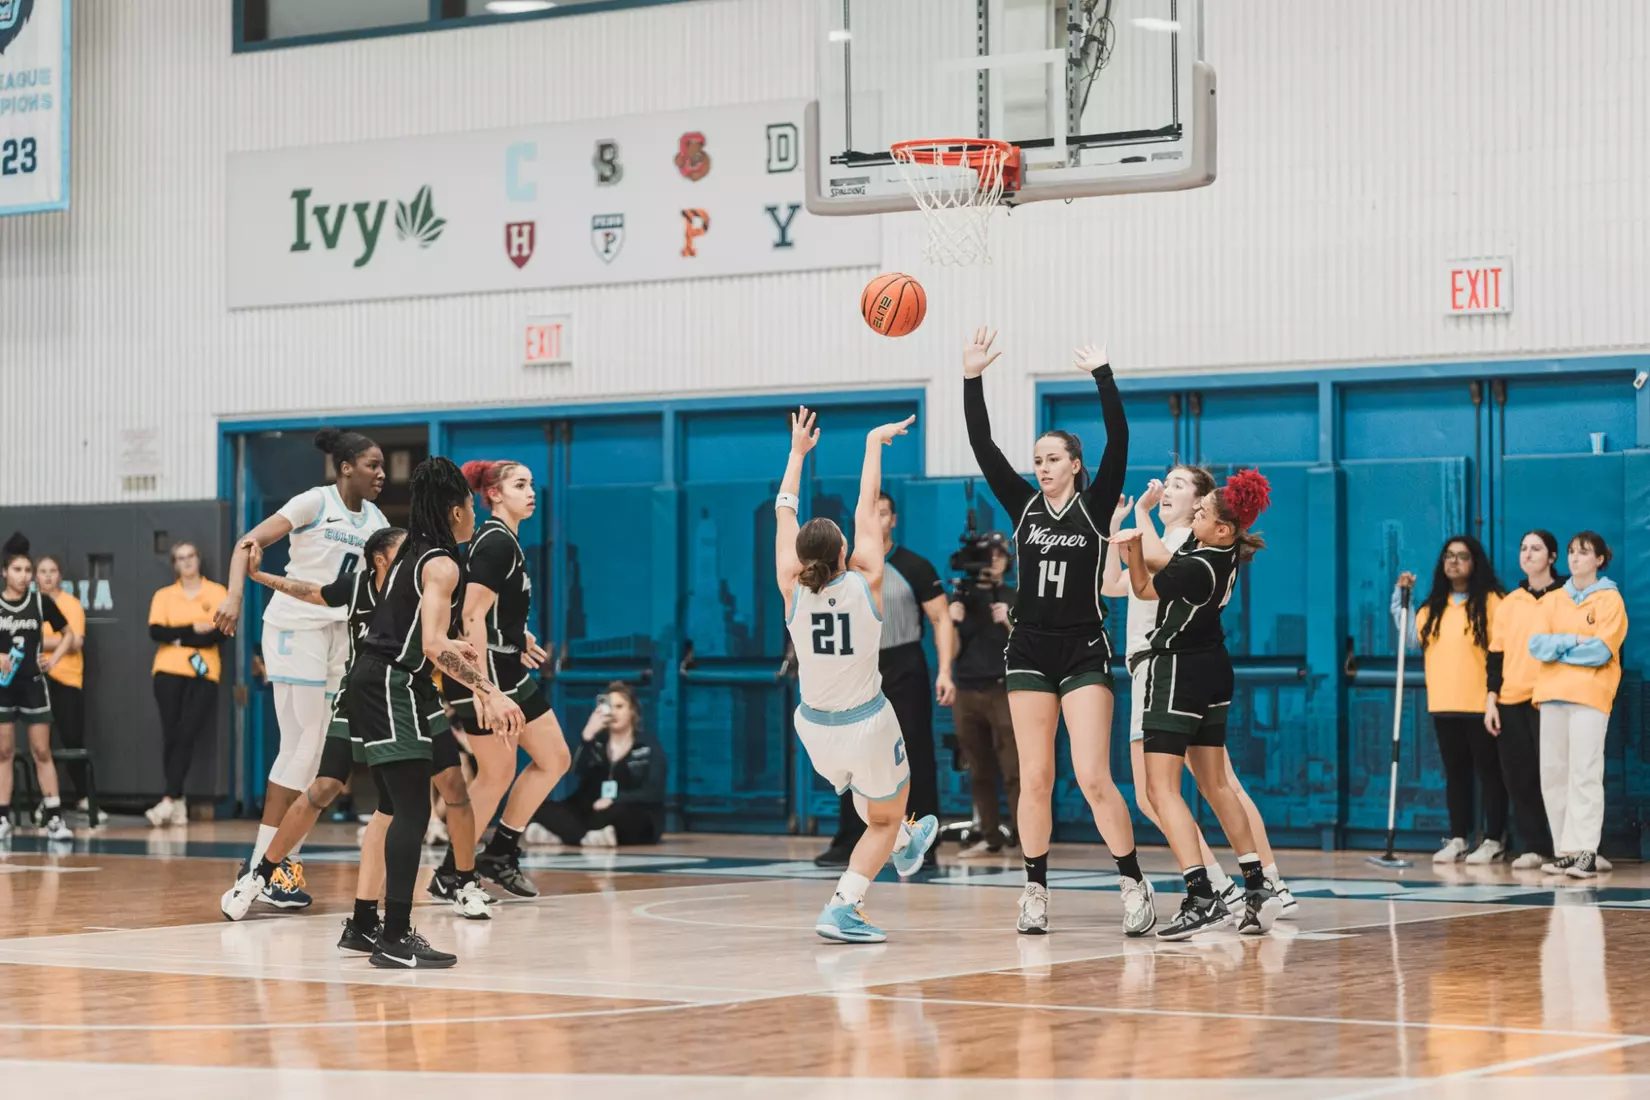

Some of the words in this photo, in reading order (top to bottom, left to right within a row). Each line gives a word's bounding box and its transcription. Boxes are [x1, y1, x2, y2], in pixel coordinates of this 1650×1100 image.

[2, 137, 37, 175] 23
[765, 122, 798, 174] D
[505, 141, 537, 201] C
[289, 187, 389, 268] Ivy
[509, 224, 531, 258] H
[680, 208, 710, 257] P
[765, 203, 801, 249] Y
[1451, 267, 1502, 309] EXIT
[872, 295, 892, 329] ELITE
[525, 323, 563, 361] EXIT
[1025, 524, 1087, 555] Wagner
[1037, 560, 1068, 598] 14
[811, 612, 854, 655] 21
